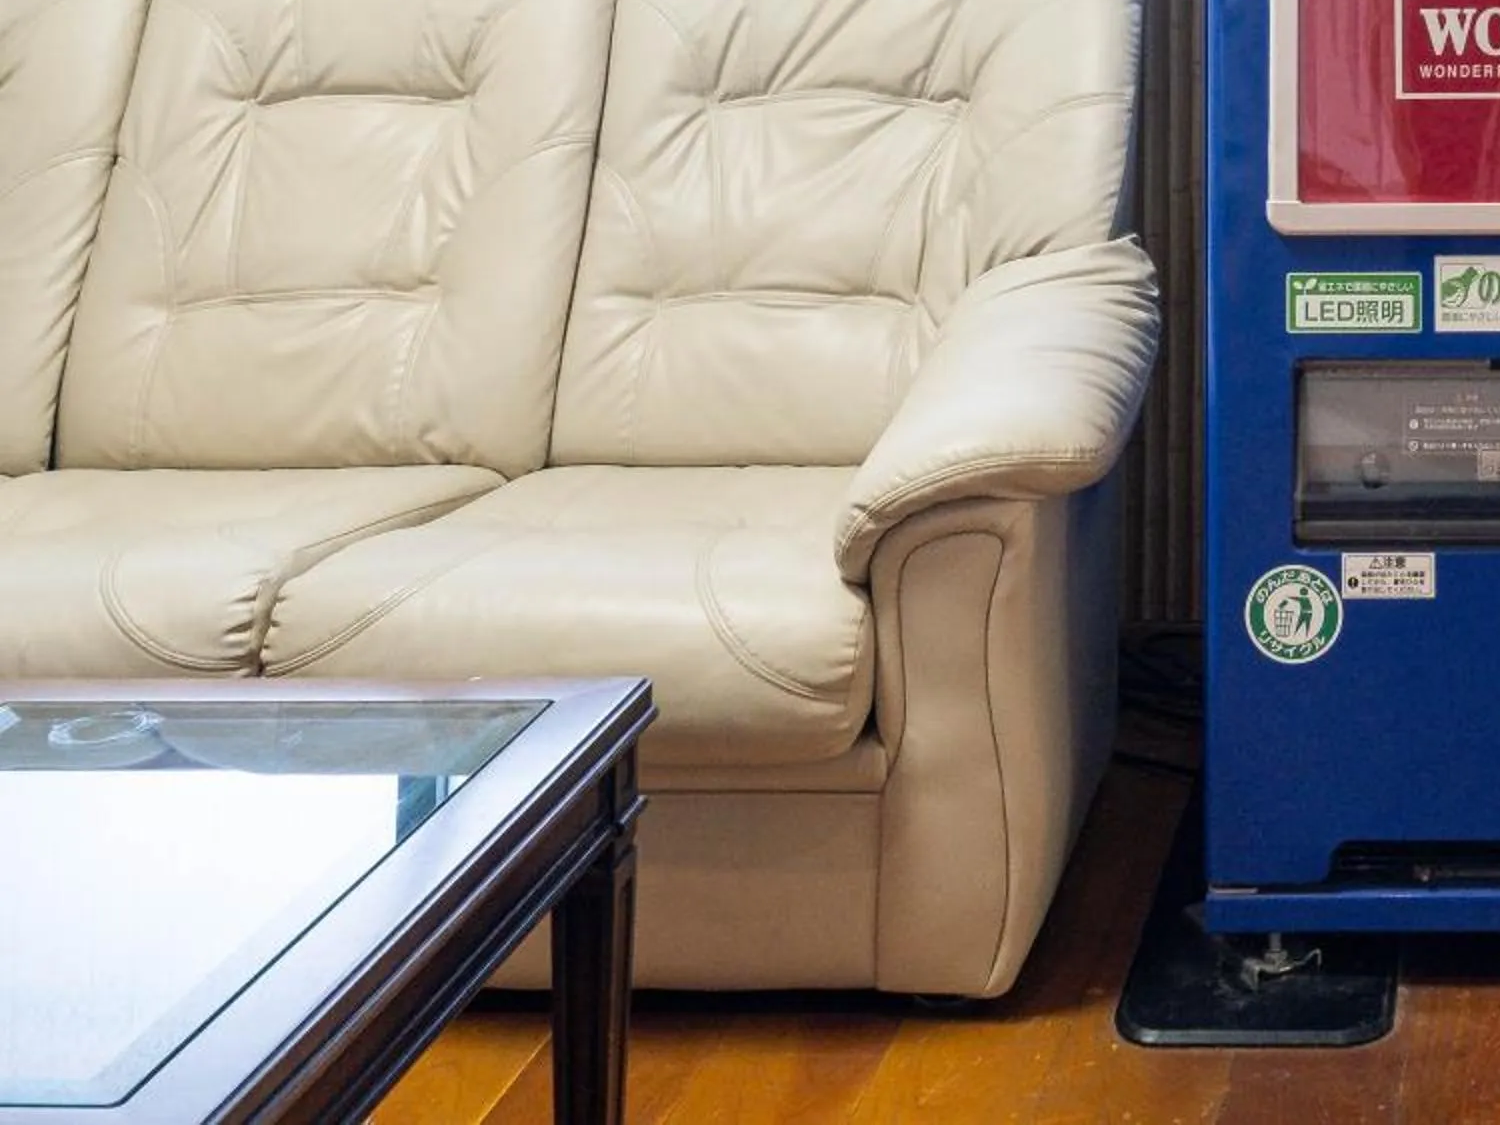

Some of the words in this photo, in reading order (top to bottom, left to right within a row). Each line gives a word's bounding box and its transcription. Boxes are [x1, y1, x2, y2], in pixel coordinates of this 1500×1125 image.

[1304, 299, 1405, 324] LED照明
[1257, 630, 1326, 658] リサイクル
